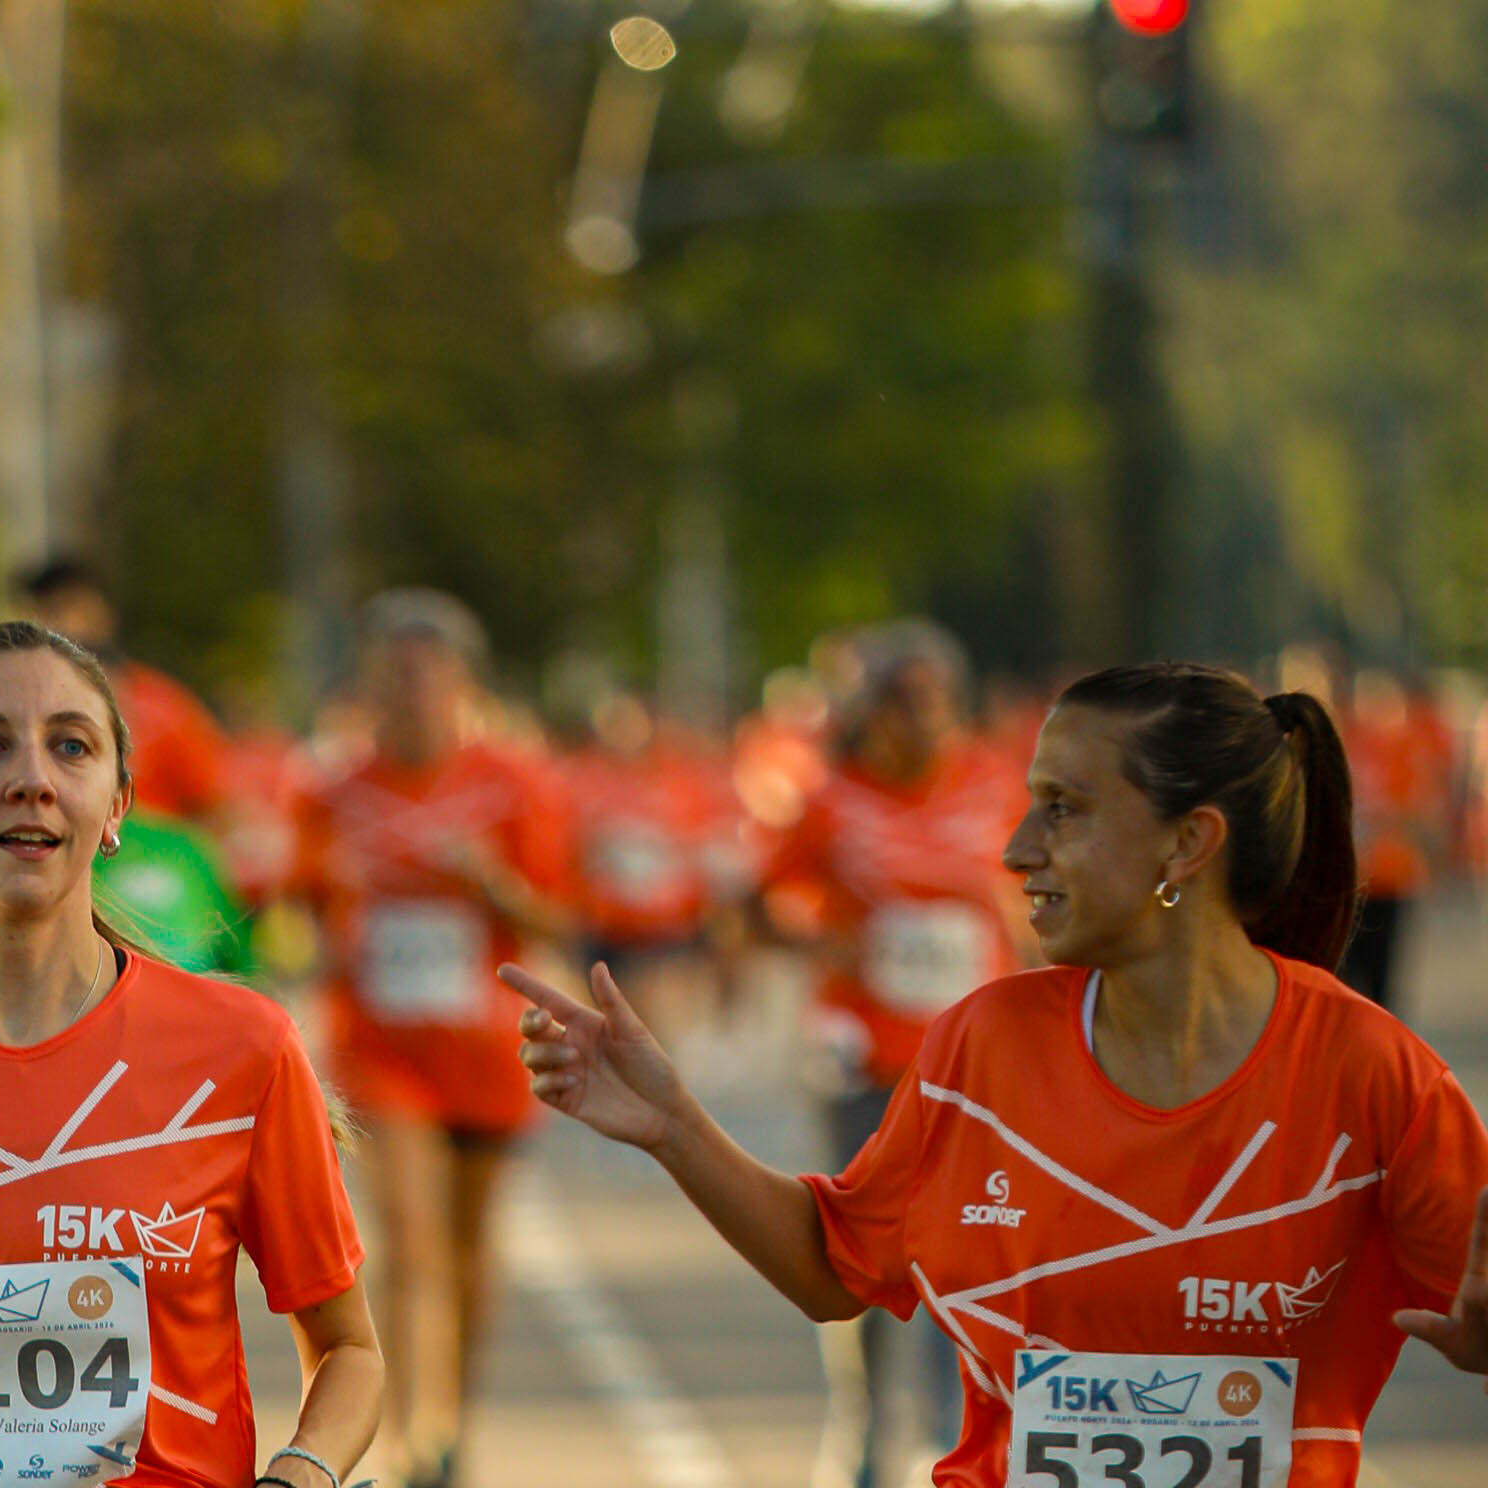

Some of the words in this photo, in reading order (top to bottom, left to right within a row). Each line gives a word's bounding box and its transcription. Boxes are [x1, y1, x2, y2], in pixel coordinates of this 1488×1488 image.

[36, 1204, 126, 1252] 15K
[145, 1260, 192, 1274] ORTE
[76, 1288, 105, 1308] 4K
[1177, 1276, 1272, 1322] 15K
[1046, 1375, 1119, 1412] 15K
[1225, 1384, 1254, 1403] 4K
[48, 1418, 106, 1436] Solange
